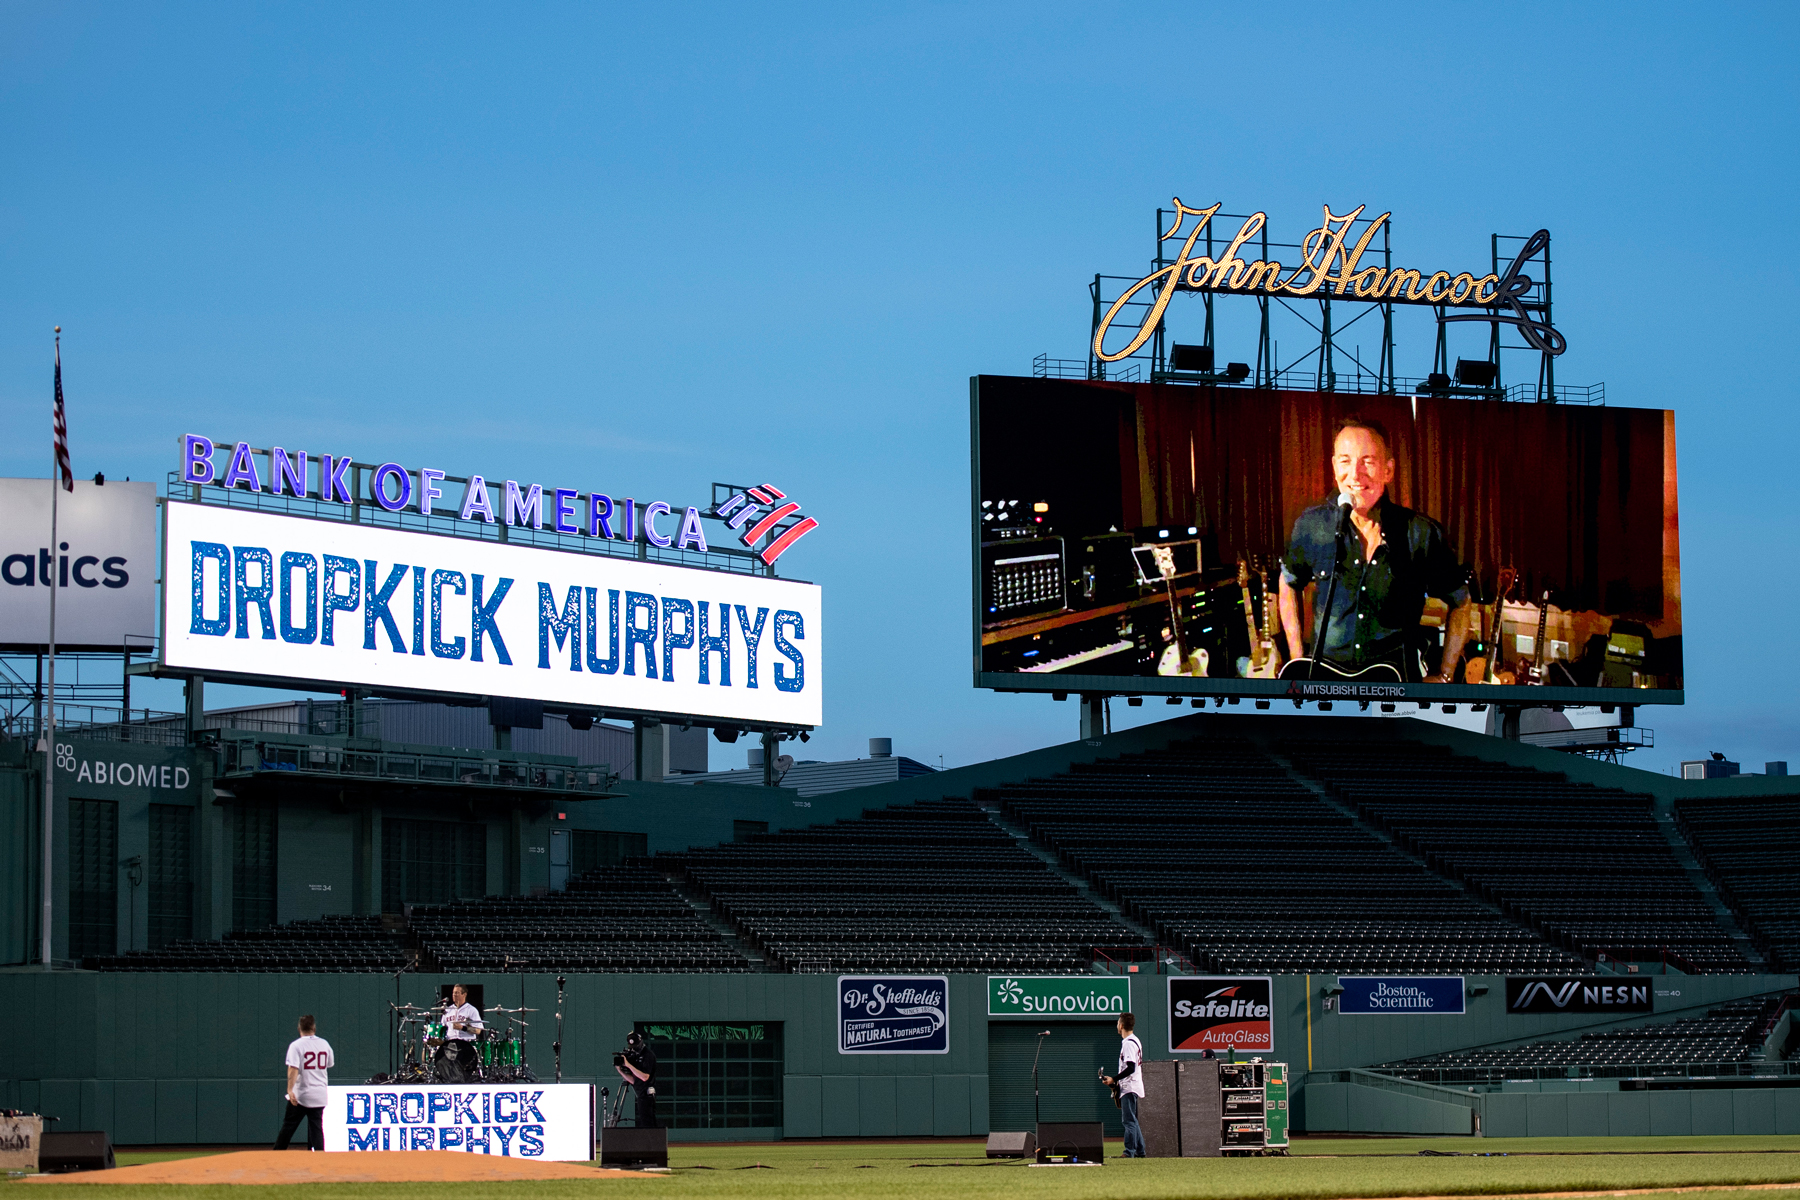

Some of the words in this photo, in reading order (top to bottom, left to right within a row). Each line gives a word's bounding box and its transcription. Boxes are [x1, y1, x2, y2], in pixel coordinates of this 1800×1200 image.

[1093, 196, 1281, 361] John
[1276, 203, 1566, 355] Hancock
[180, 433, 354, 504] BANK
[369, 462, 446, 515] OF
[458, 475, 708, 552] AMERICA
[1, 541, 130, 589] atics
[189, 540, 514, 666] DROPKICK
[537, 581, 805, 693] MURPHYS
[1303, 684, 1357, 695] MITSUBISHI
[1359, 686, 1406, 697] ELECTRIC
[77, 760, 190, 789] ABIOMED
[843, 989, 869, 1009] Dr.
[866, 983, 941, 1016] Sheffield's
[1369, 991, 1434, 1008] Scientific
[1378, 982, 1419, 997] Boston
[1583, 986, 1647, 1005] NESN
[1022, 990, 1123, 1012] sunovion
[1174, 999, 1269, 1018] Safelite
[847, 1027, 892, 1045] NATURAL
[1202, 1029, 1270, 1043] AutoGlass
[303, 1051, 328, 1070] 20
[346, 1090, 547, 1125] DROPKICK
[347, 1124, 545, 1157] MURPHYS
